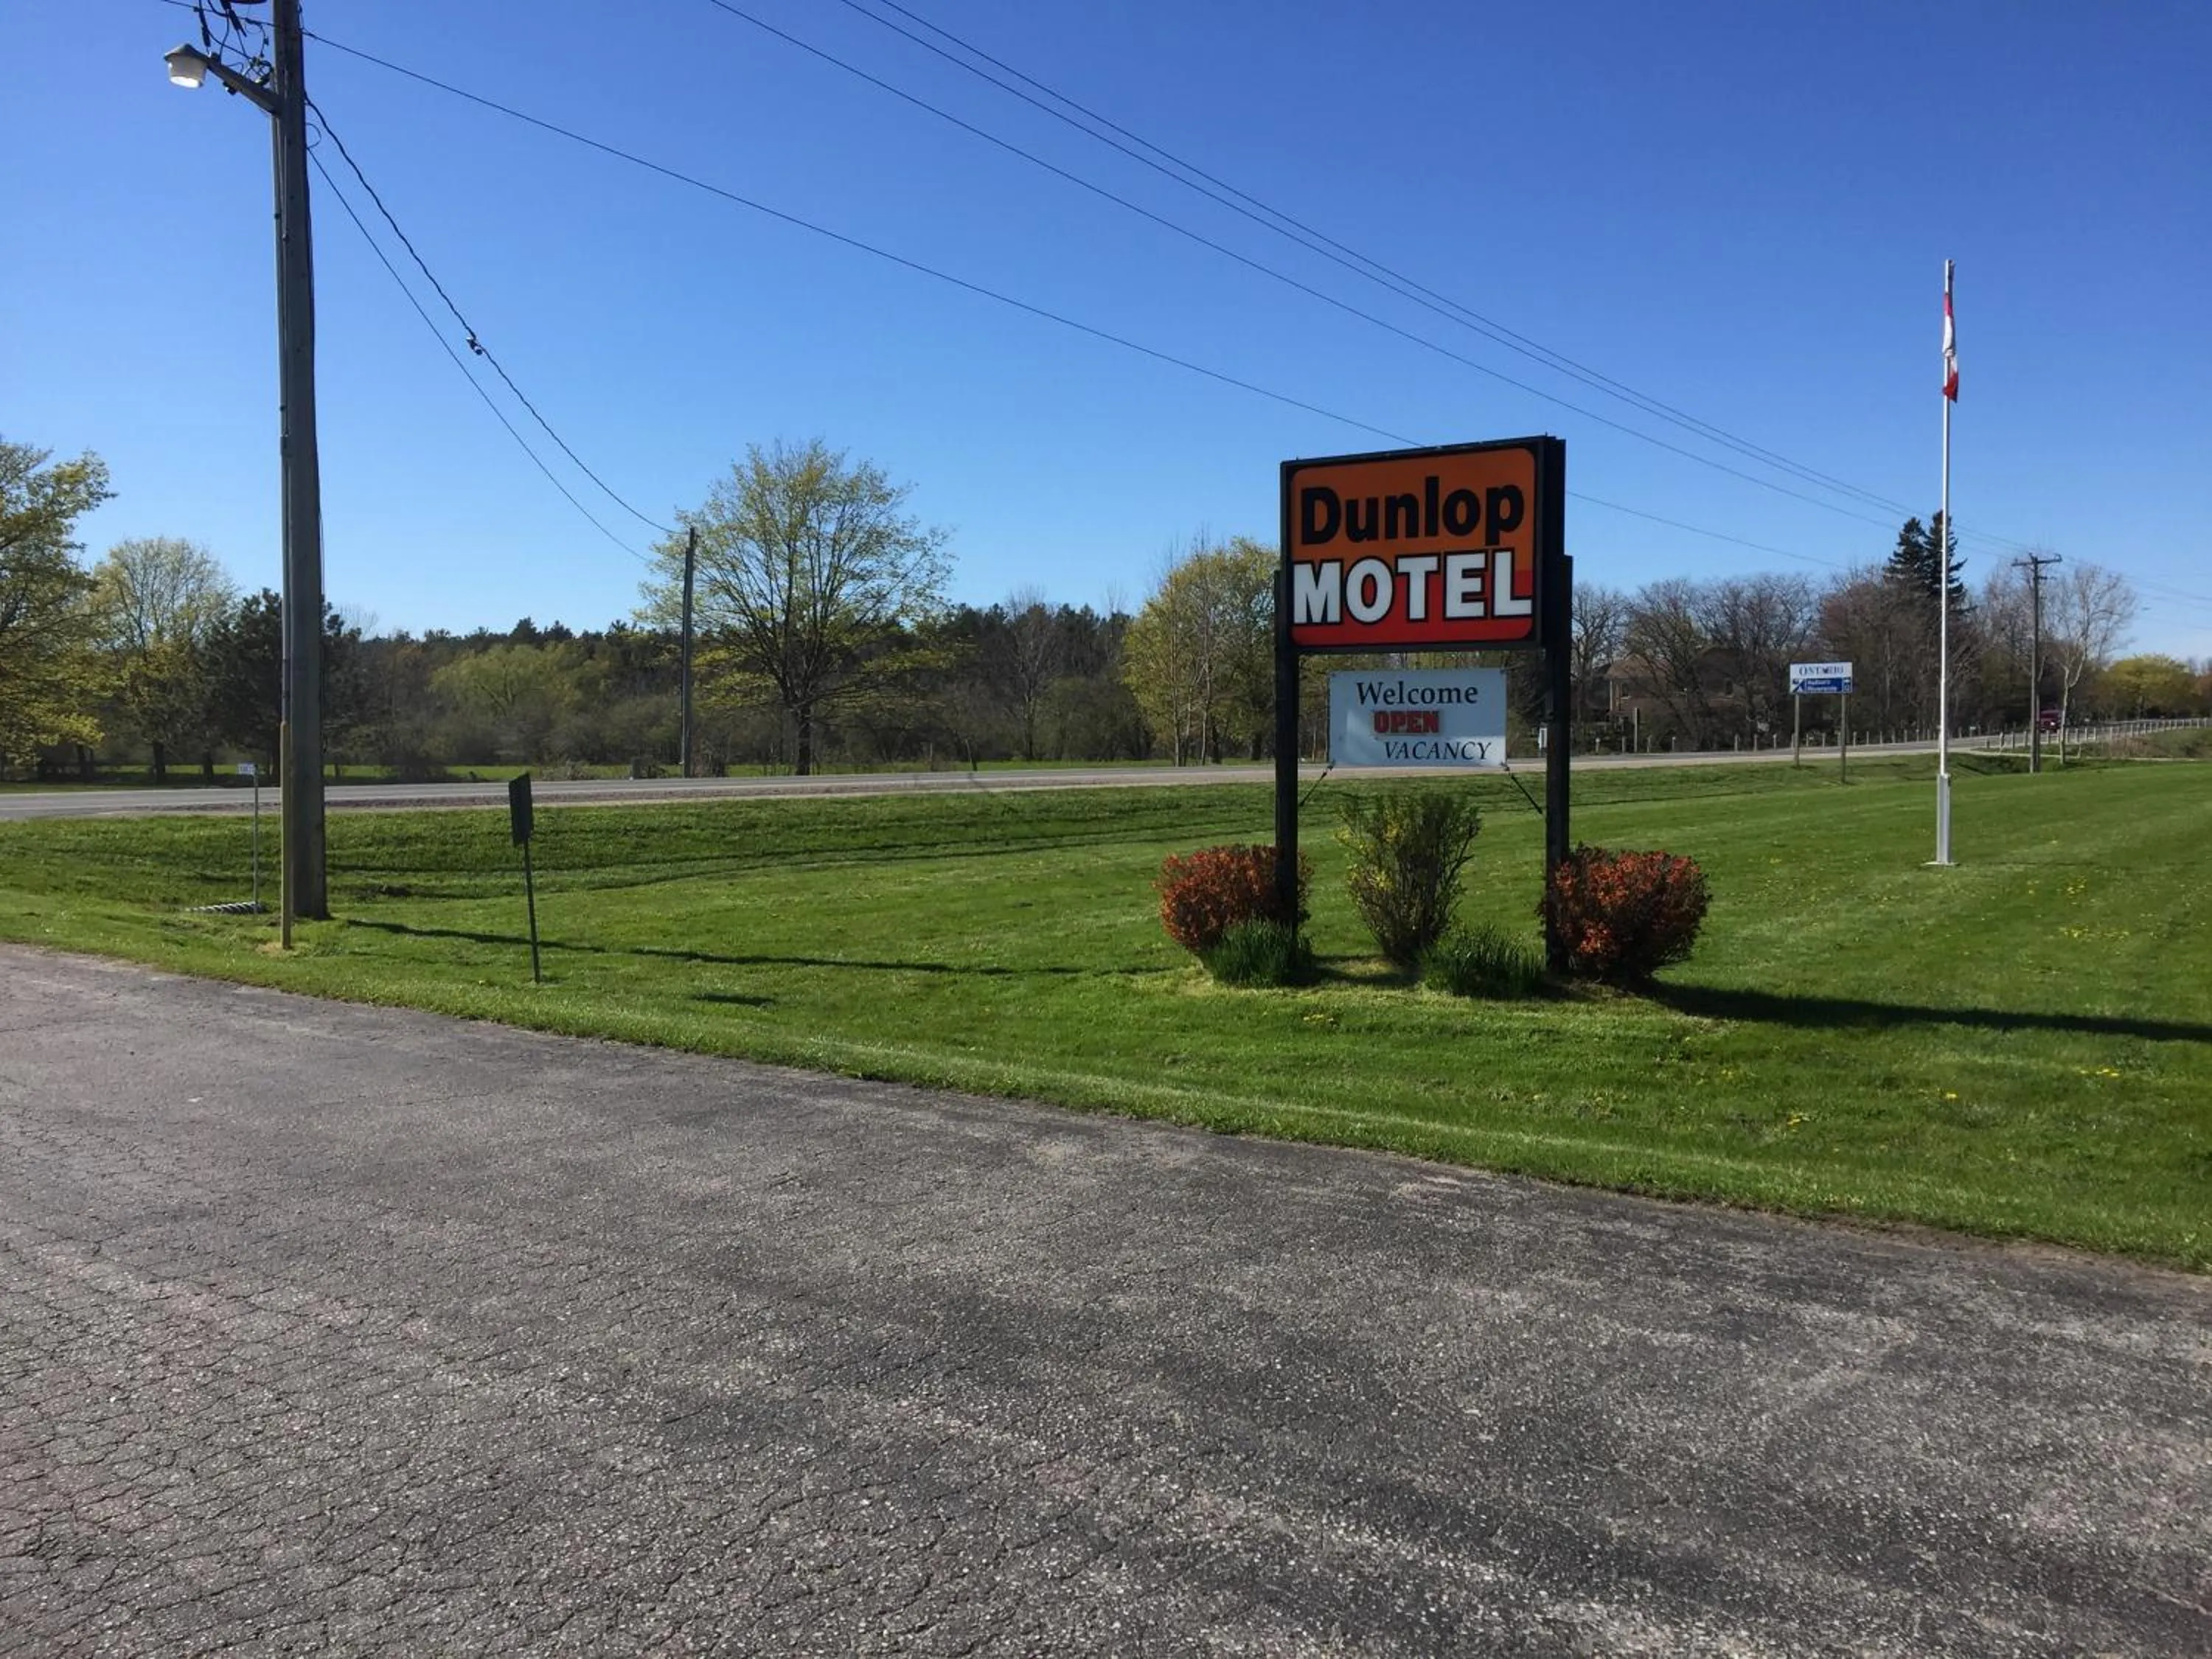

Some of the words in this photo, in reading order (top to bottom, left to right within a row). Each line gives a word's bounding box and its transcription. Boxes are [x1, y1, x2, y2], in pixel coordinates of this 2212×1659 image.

[1301, 476, 1524, 545] Dunlop
[1293, 549, 1533, 625] MOTEL
[1357, 681, 1478, 706] Welcome
[1373, 710, 1441, 734] OPEN
[1384, 741, 1492, 761] VACANCY
